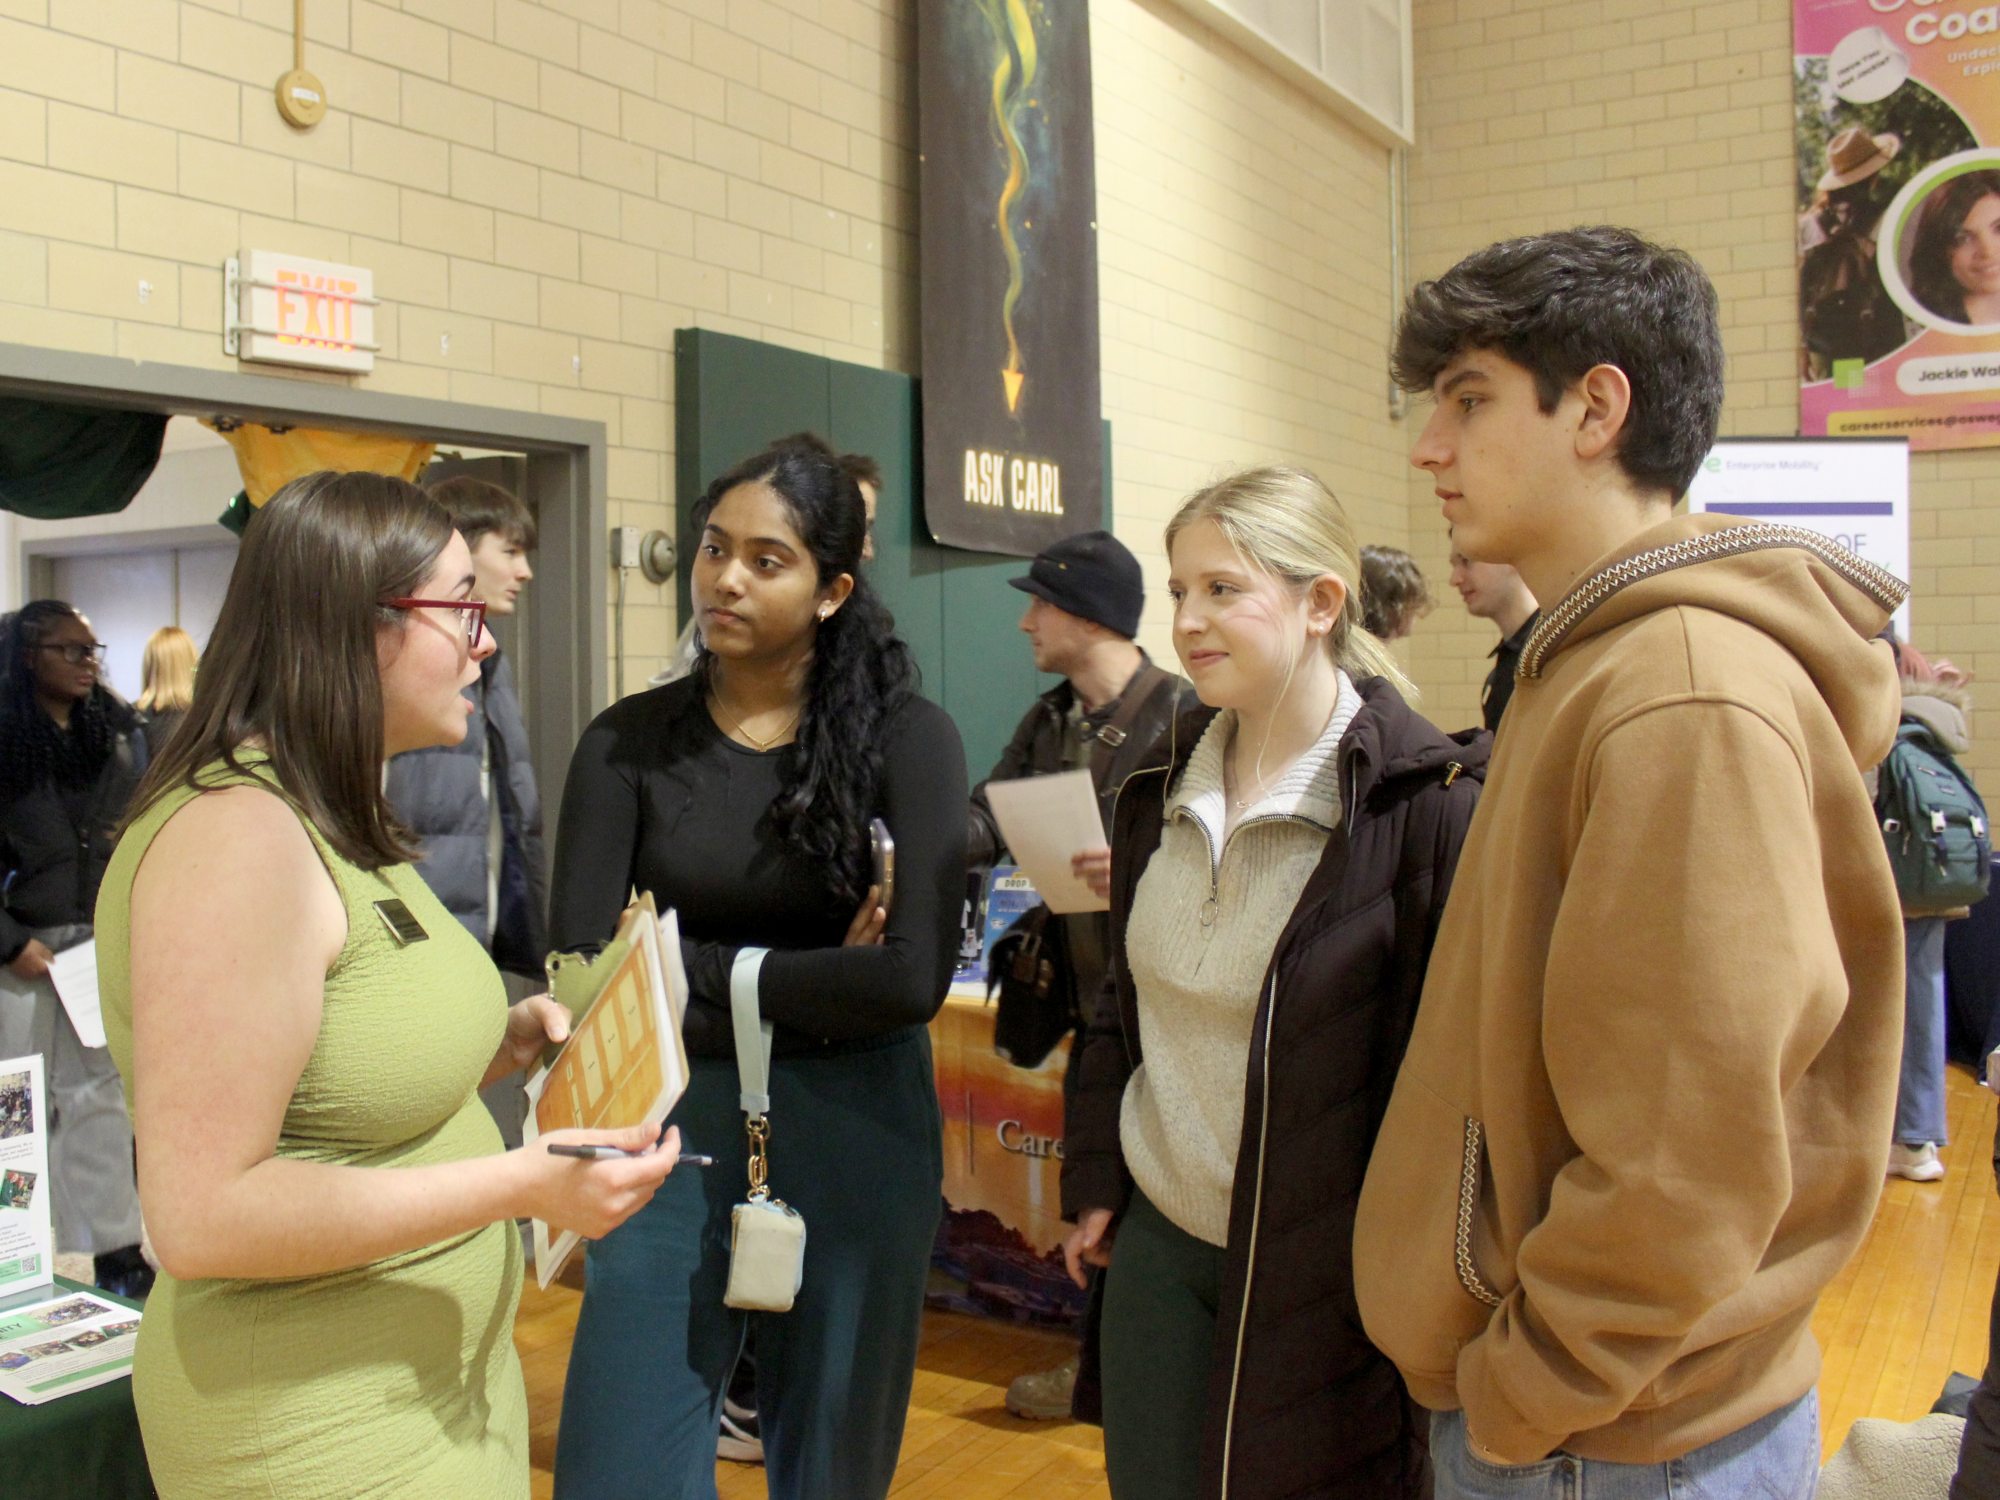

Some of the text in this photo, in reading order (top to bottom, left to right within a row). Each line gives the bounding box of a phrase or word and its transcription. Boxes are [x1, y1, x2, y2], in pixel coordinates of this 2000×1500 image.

[1904, 6, 1998, 45] Coa
[276, 269, 357, 352] EXIT
[1918, 366, 1969, 382] Jackie
[964, 449, 1064, 515] ASK CARL
[1726, 460, 1777, 472] Enterprise
[1004, 879, 1028, 888] DROP
[996, 1119, 1065, 1159] Care
